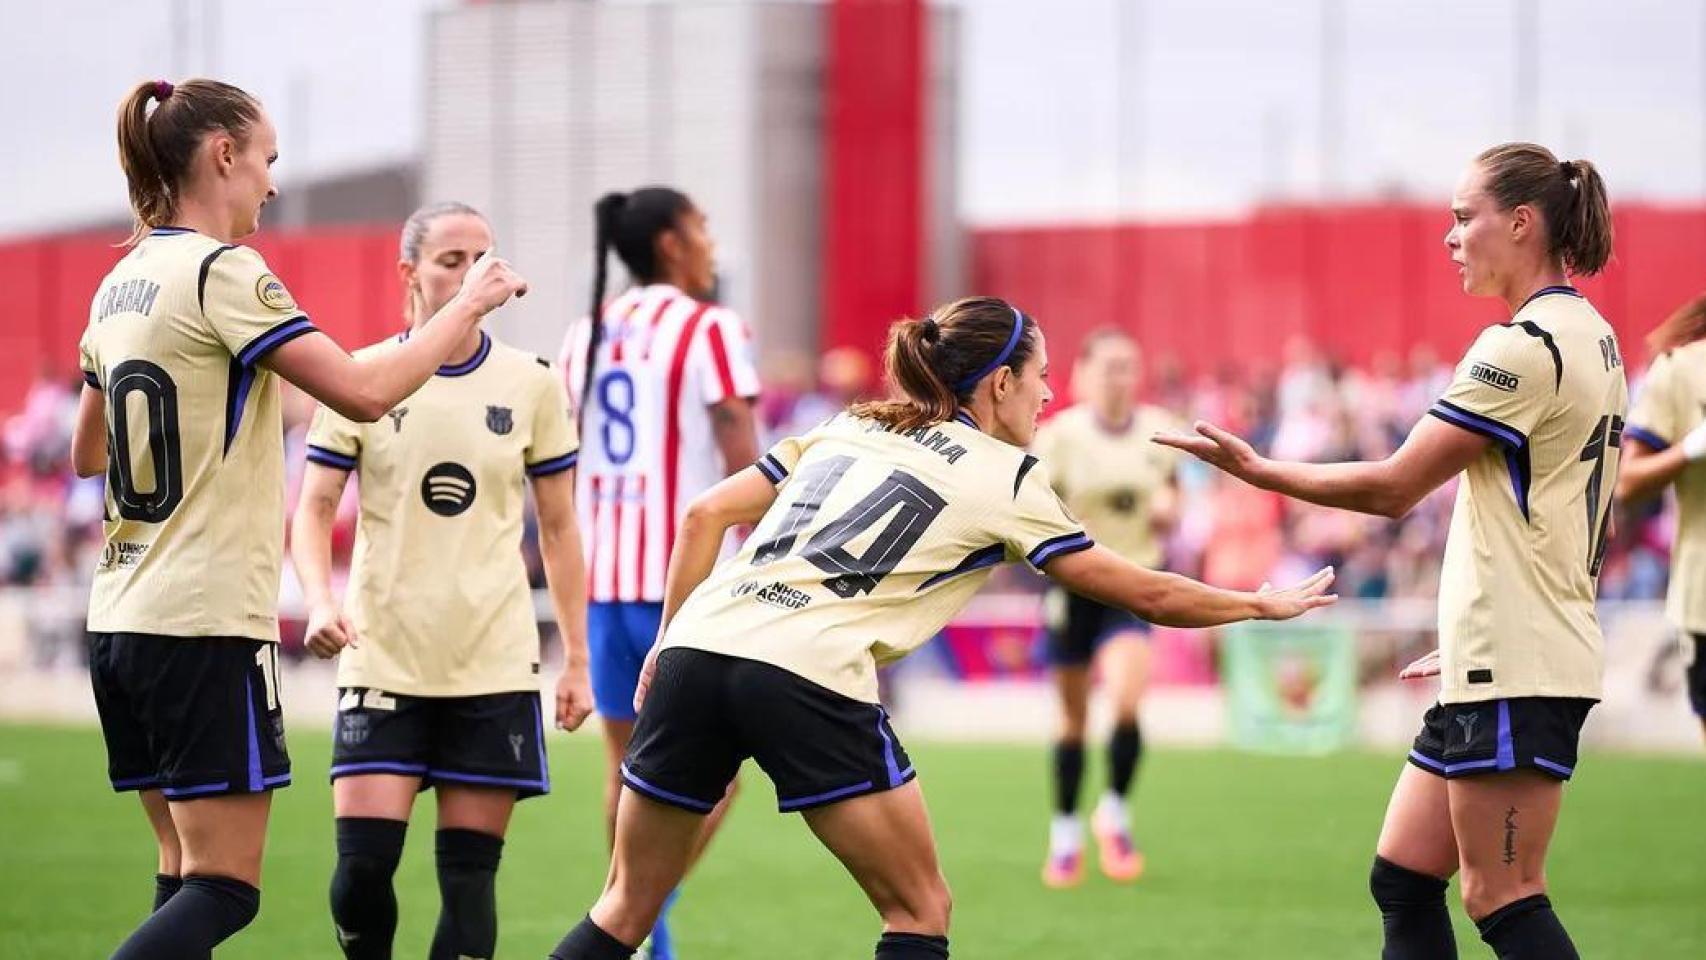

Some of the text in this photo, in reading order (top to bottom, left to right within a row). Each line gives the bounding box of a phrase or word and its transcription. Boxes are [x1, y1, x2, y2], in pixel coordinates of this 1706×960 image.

[597, 369, 635, 465] 8
[1471, 364, 1519, 389] BIMBO
[103, 361, 184, 523] 0
[750, 453, 949, 599] 14
[767, 581, 812, 604] NHCR
[255, 643, 281, 712] 1
